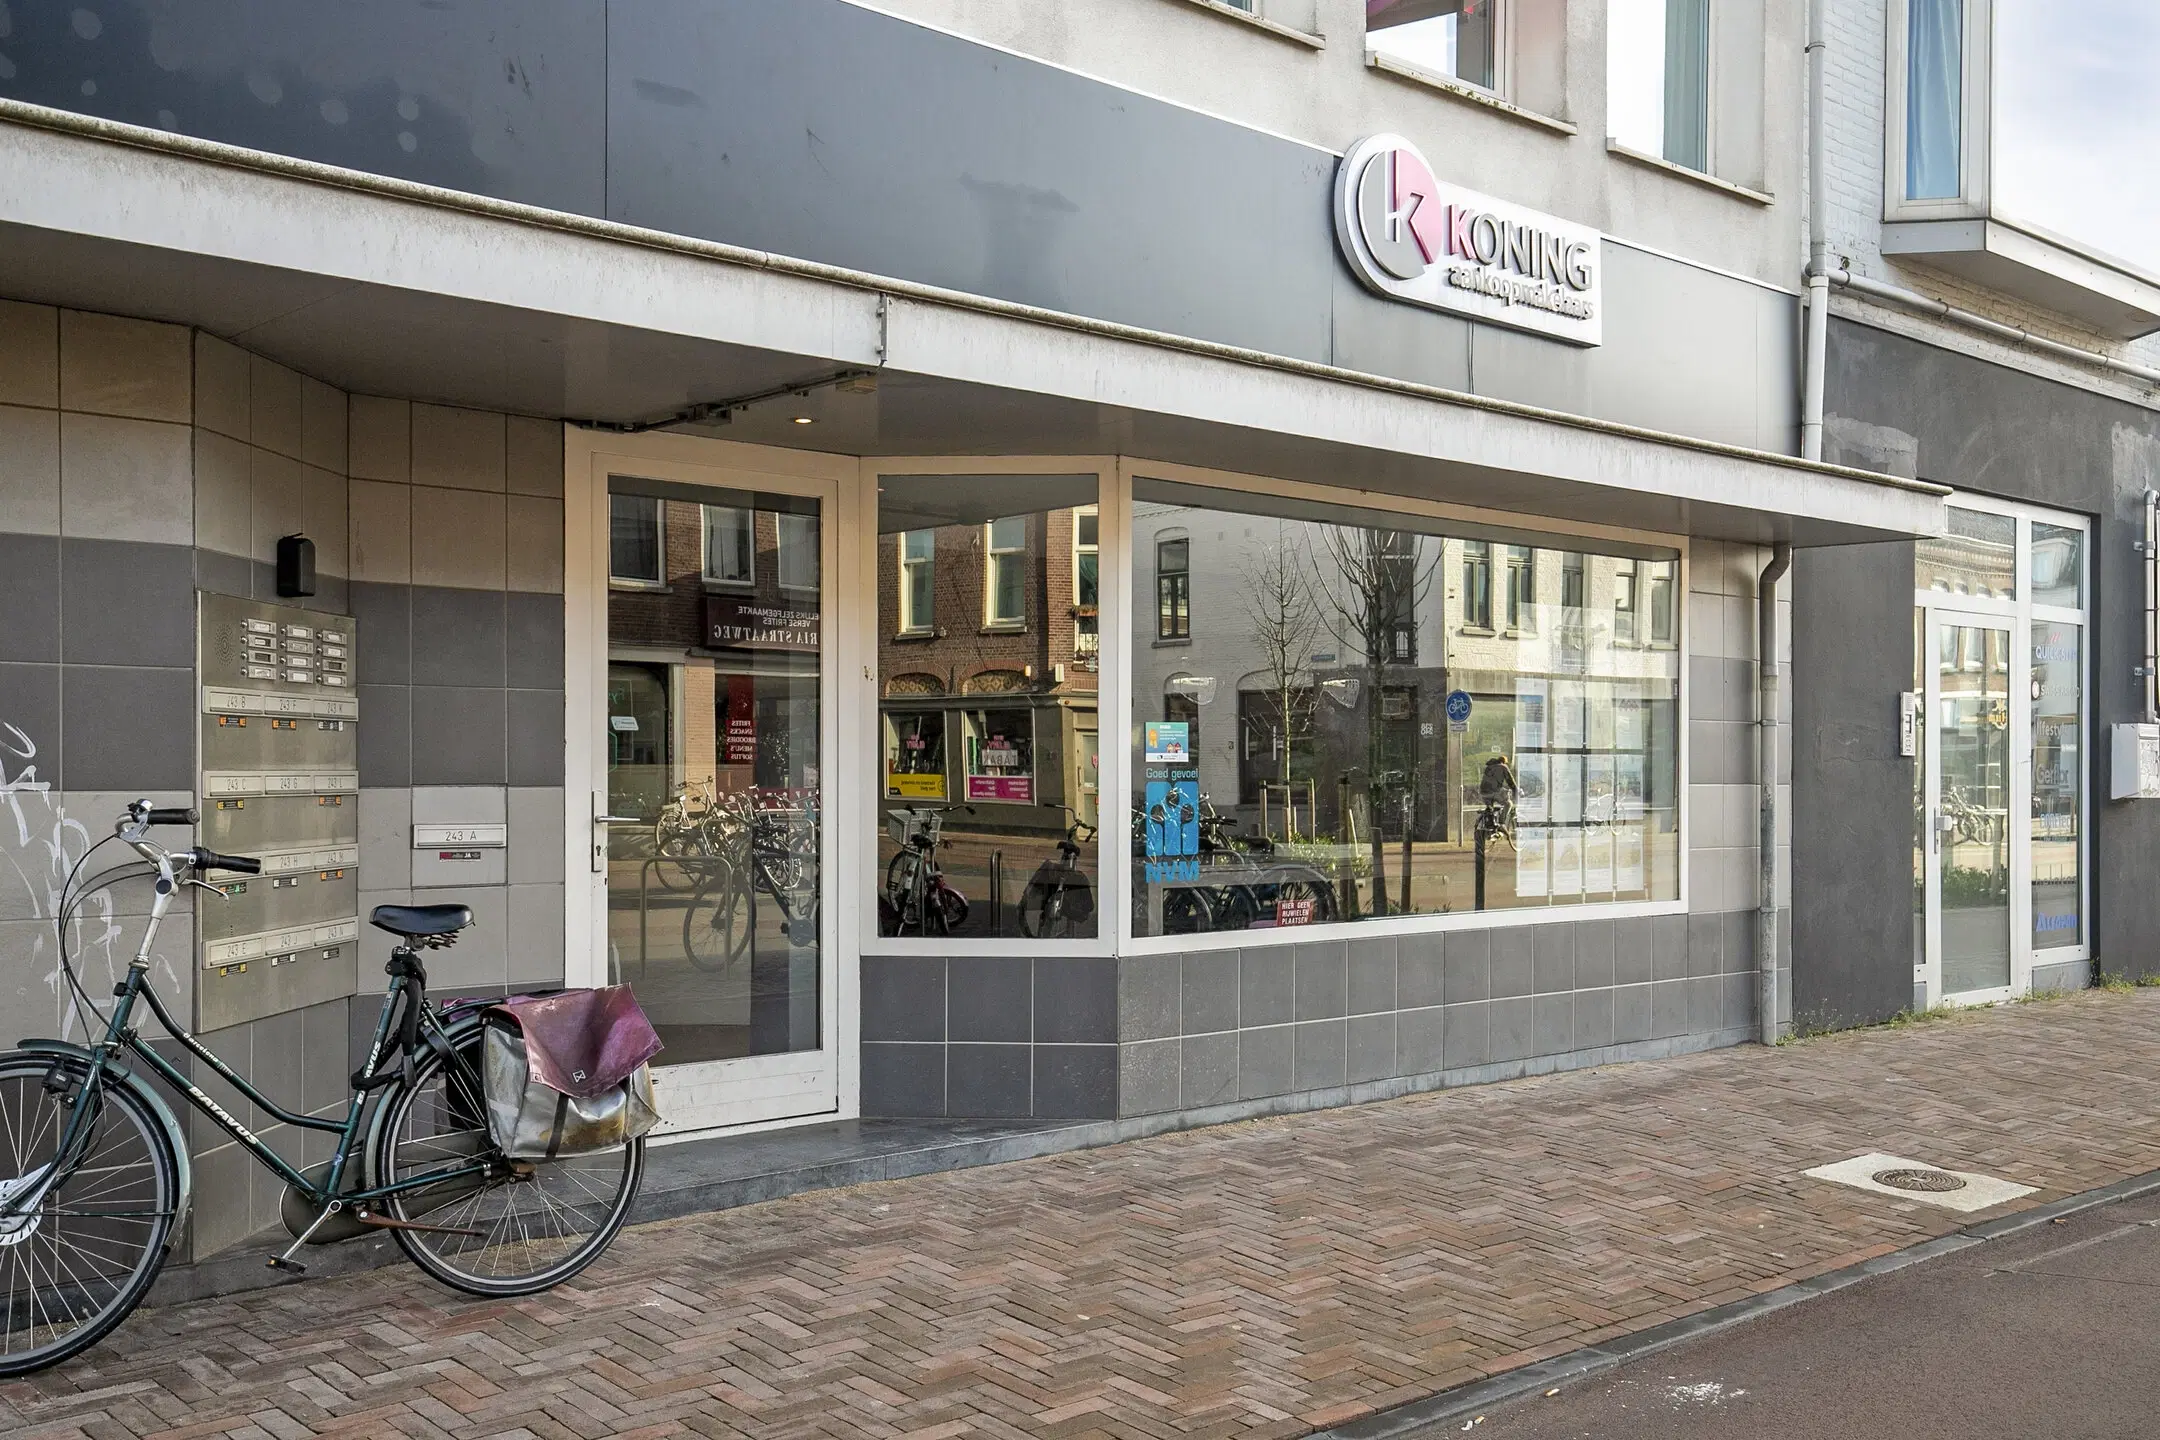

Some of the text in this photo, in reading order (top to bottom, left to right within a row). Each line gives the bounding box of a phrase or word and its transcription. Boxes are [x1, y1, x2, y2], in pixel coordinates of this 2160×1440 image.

[1448, 204, 1593, 291] KONING
[1447, 265, 1595, 322] aankoopmakelaars
[1145, 768, 1168, 778] Goed
[445, 830, 477, 841] 243 A
[1144, 859, 1199, 884] NVM
[1281, 902, 1294, 910] HIER
[1281, 916, 1308, 925] PLAATSEN
[357, 1040, 382, 1106] BAVUS
[188, 1086, 260, 1145] BATAVUS
